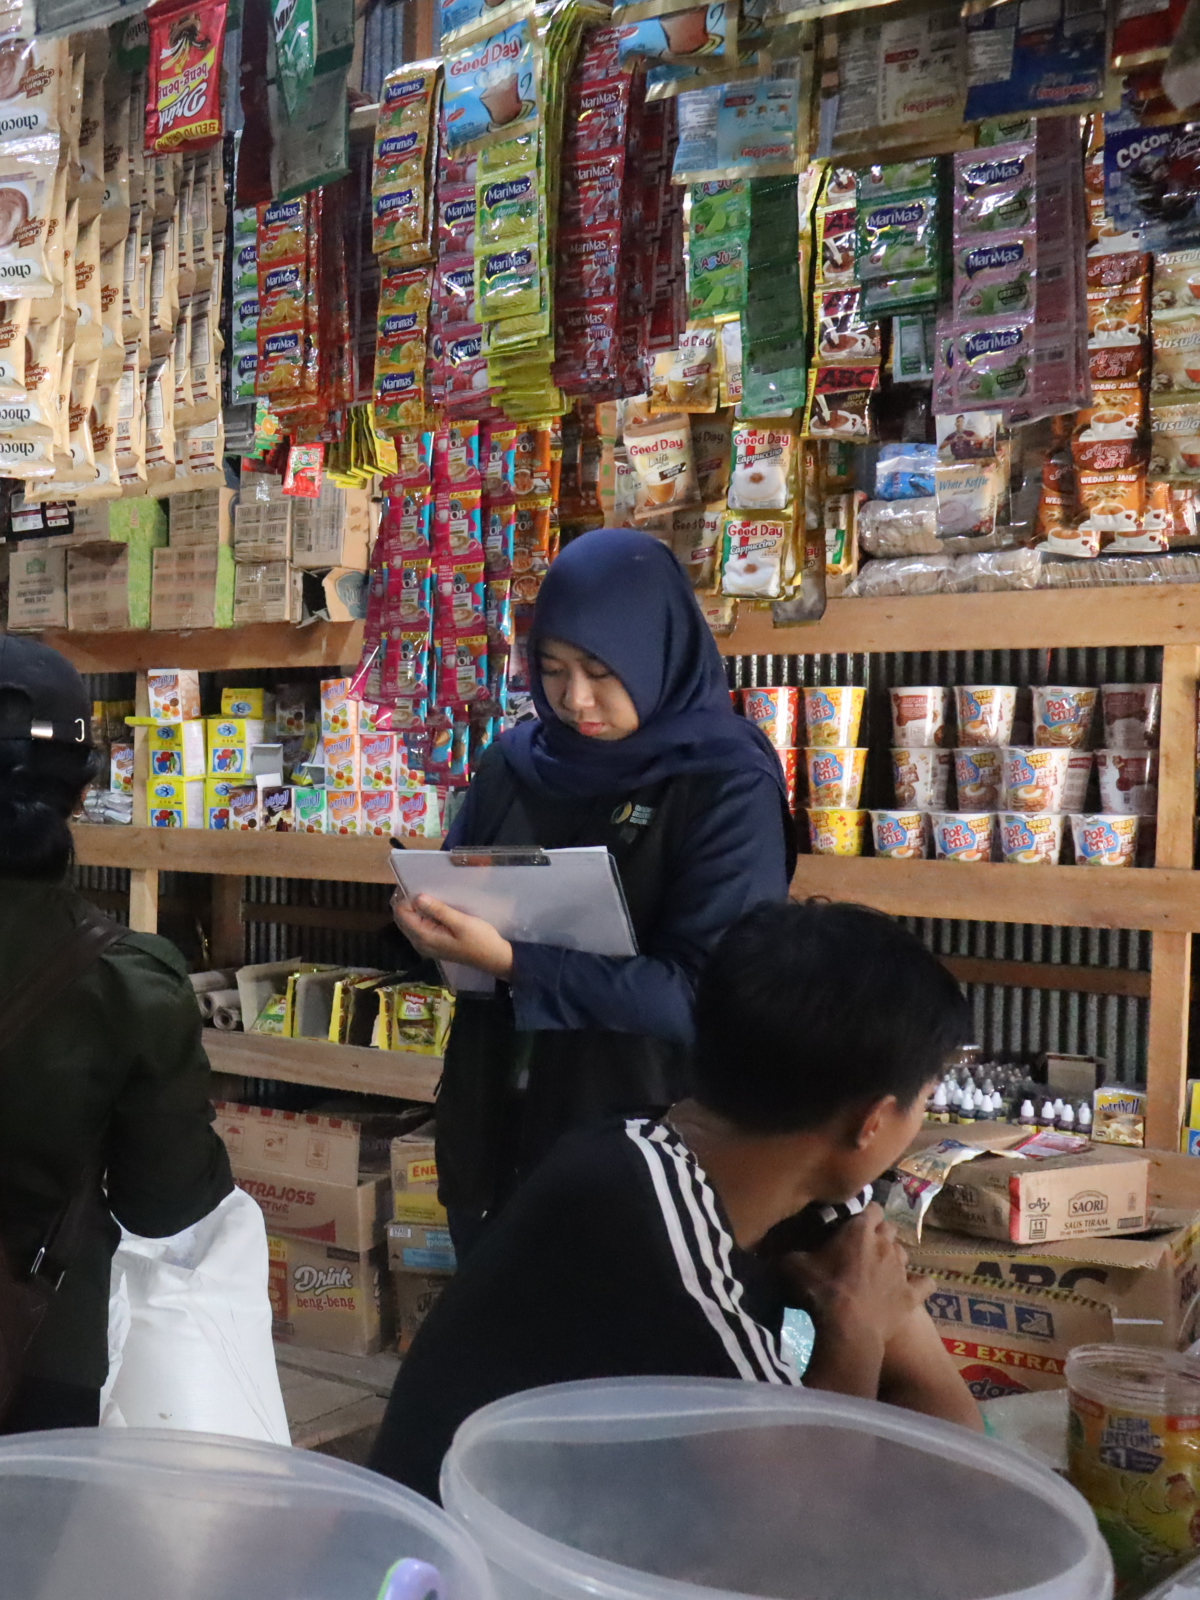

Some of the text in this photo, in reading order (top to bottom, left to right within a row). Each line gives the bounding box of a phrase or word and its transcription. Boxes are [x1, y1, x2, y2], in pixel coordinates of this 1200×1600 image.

[450, 40, 520, 77] Good Day
[158, 82, 208, 134] Drink
[489, 181, 528, 202] MariMas
[447, 205, 477, 219] MariMa
[827, 212, 856, 232] AB
[489, 253, 528, 272] MariMas
[1087, 290, 1120, 300] WEDANG
[452, 339, 482, 356] MariMa
[691, 336, 713, 349] Day
[1091, 383, 1117, 391] EDANG
[630, 438, 684, 457] Good Day
[734, 433, 791, 447] Good Day
[736, 447, 783, 465] Cappuccino
[939, 478, 963, 492] White
[1080, 475, 1115, 485] WEDANG
[727, 523, 783, 538] Good Day
[729, 539, 776, 556] Cappuccino
[236, 1178, 317, 1206] XTRAJOSS
[1071, 1199, 1104, 1214] SAORI
[1033, 1220, 1044, 1229] 11
[1064, 1217, 1109, 1230] SAUS TIRAM
[294, 1264, 353, 1296] Drink
[296, 1294, 355, 1311] beng-beng
[953, 1341, 1059, 1373] 2 EXTRA
[1108, 1415, 1149, 1430] LEBIH
[1103, 1433, 1163, 1450] UNTUNG
